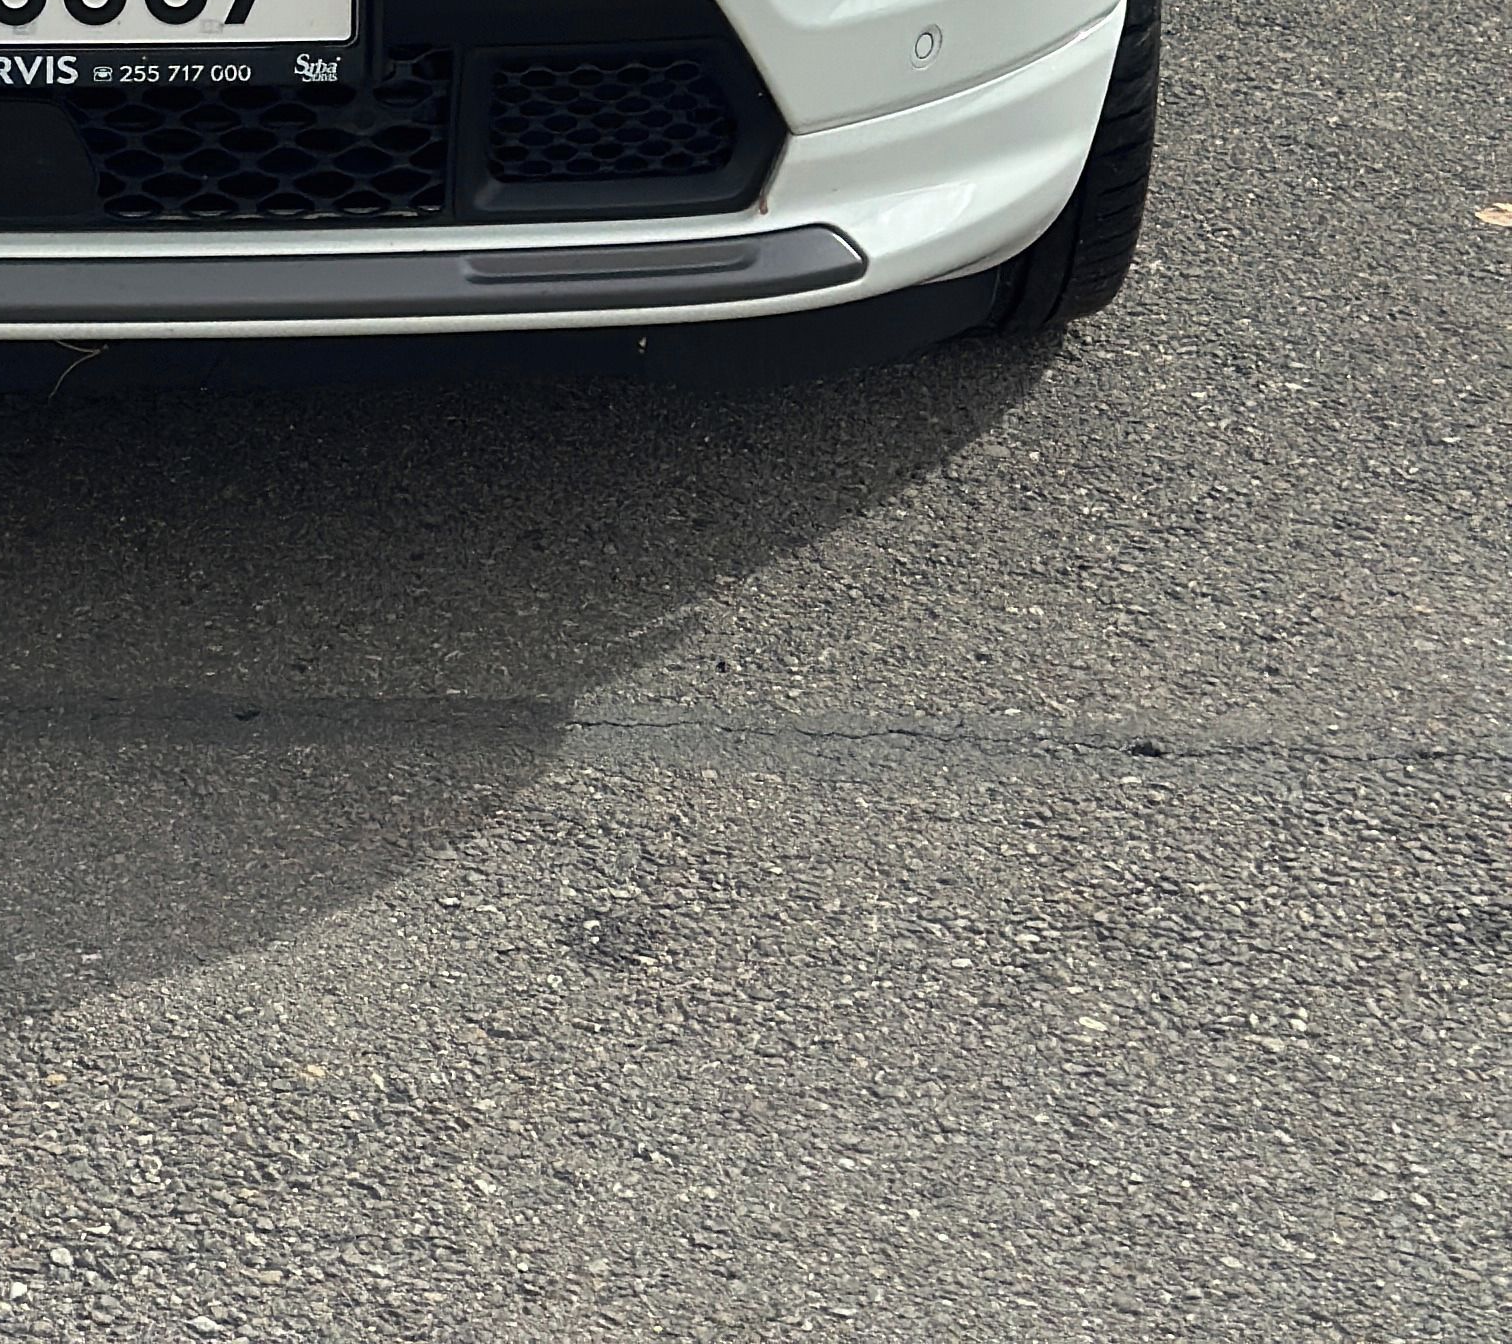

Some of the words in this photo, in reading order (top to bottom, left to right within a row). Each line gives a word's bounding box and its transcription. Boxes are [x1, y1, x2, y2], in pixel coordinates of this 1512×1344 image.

[119, 65, 160, 82] 255
[167, 65, 205, 82] 717
[210, 65, 252, 82] 000
